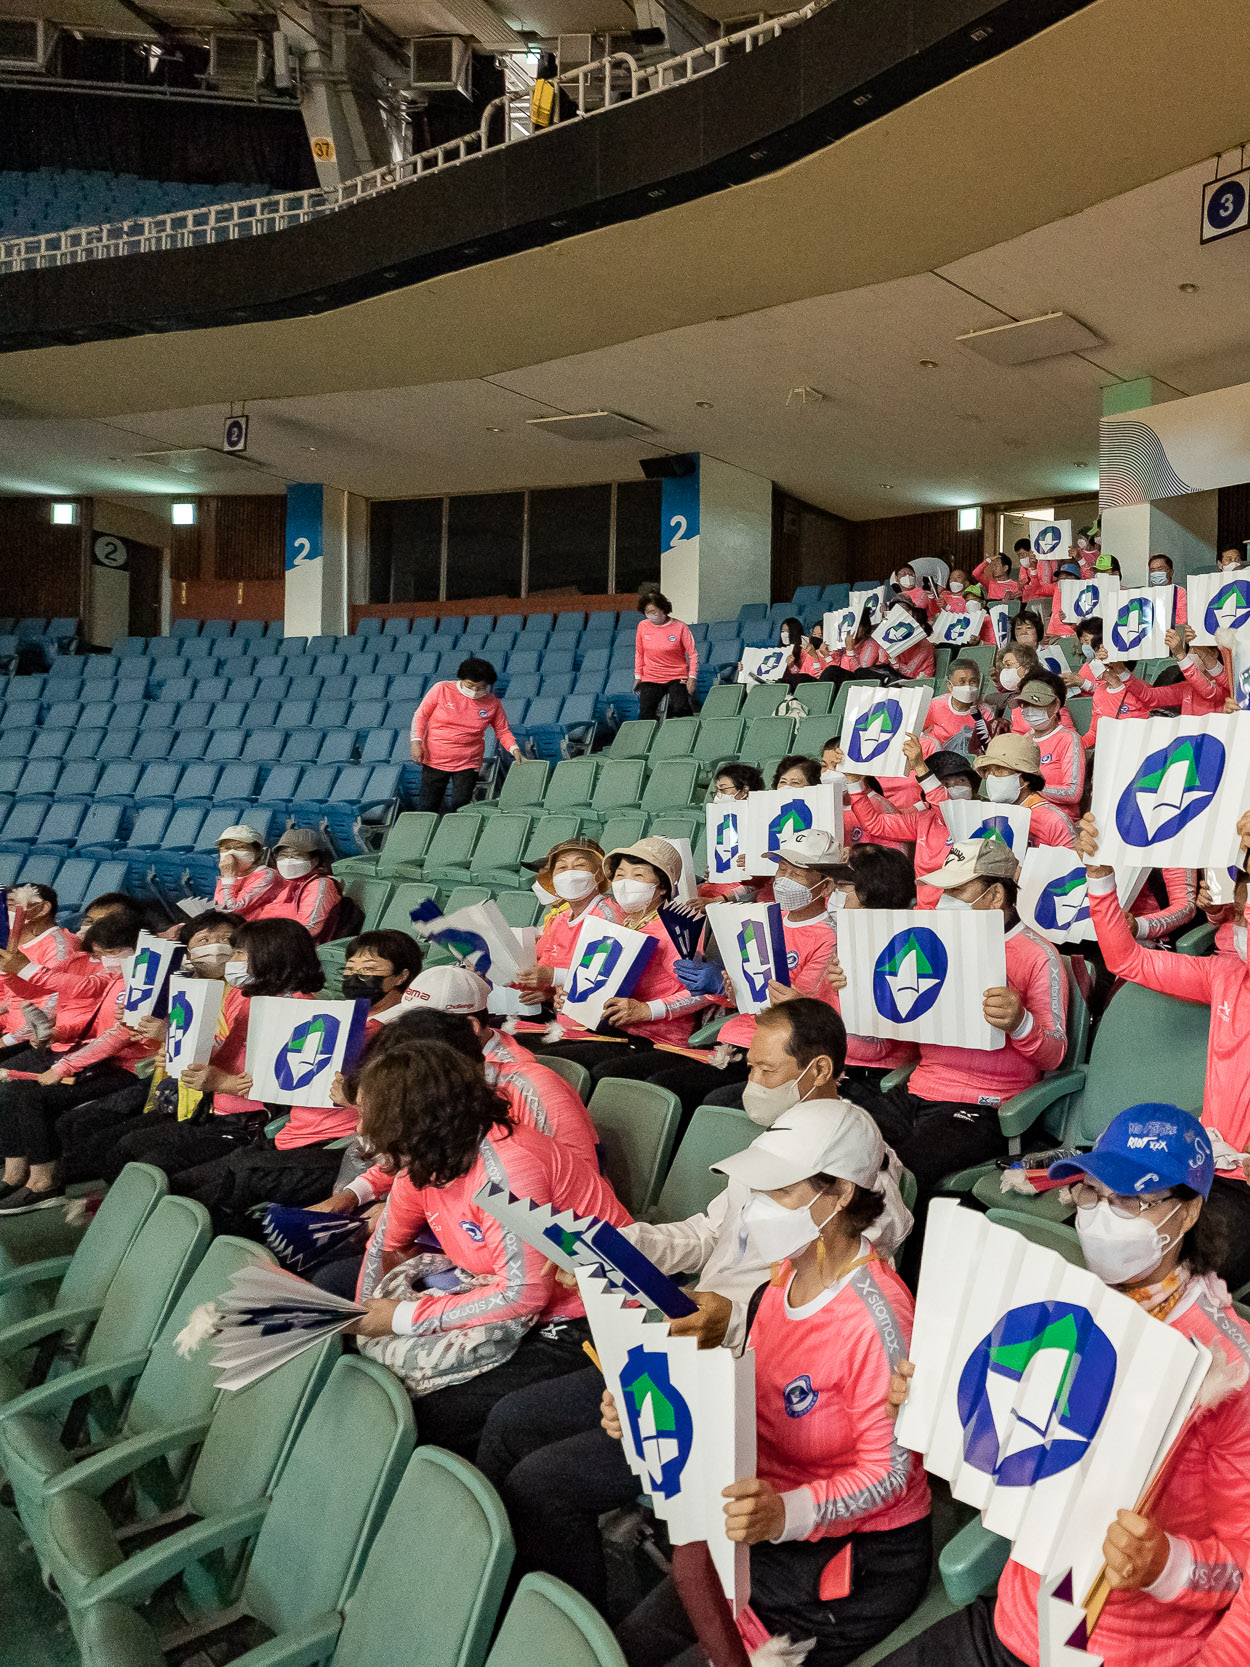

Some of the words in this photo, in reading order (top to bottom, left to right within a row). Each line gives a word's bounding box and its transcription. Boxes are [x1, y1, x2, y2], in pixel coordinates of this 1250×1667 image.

[315, 142, 330, 158] 37
[1219, 193, 1234, 217] 3
[231, 427, 240, 441] 2
[670, 515, 687, 547] 2
[104, 541, 118, 562] 2
[294, 537, 311, 566] 2
[868, 1294, 900, 1354] stomax
